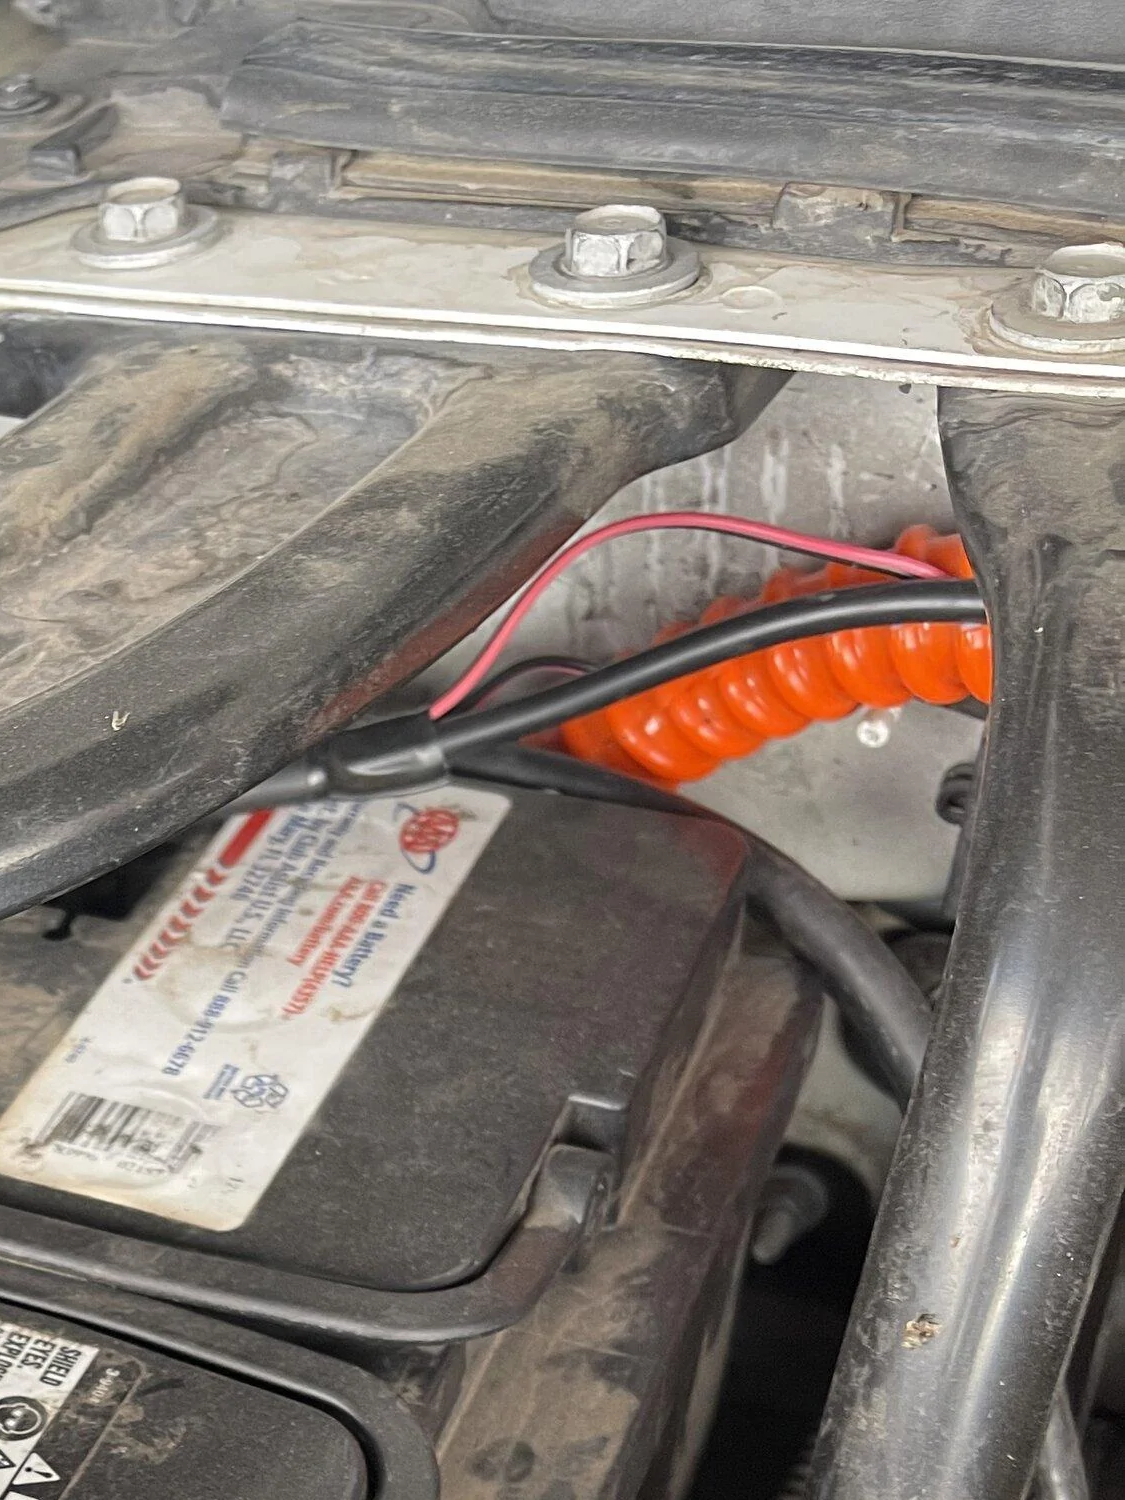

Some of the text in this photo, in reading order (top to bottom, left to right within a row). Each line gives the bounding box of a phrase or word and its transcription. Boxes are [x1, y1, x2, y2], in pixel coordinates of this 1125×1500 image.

[218, 927, 252, 952] LLC
[327, 882, 417, 988] Need a Battery?
[219, 969, 249, 993] Call
[160, 994, 232, 1077] 888-912-6678
[17, 1338, 56, 1372] EYES.
[38, 1345, 82, 1387] SHIELD
